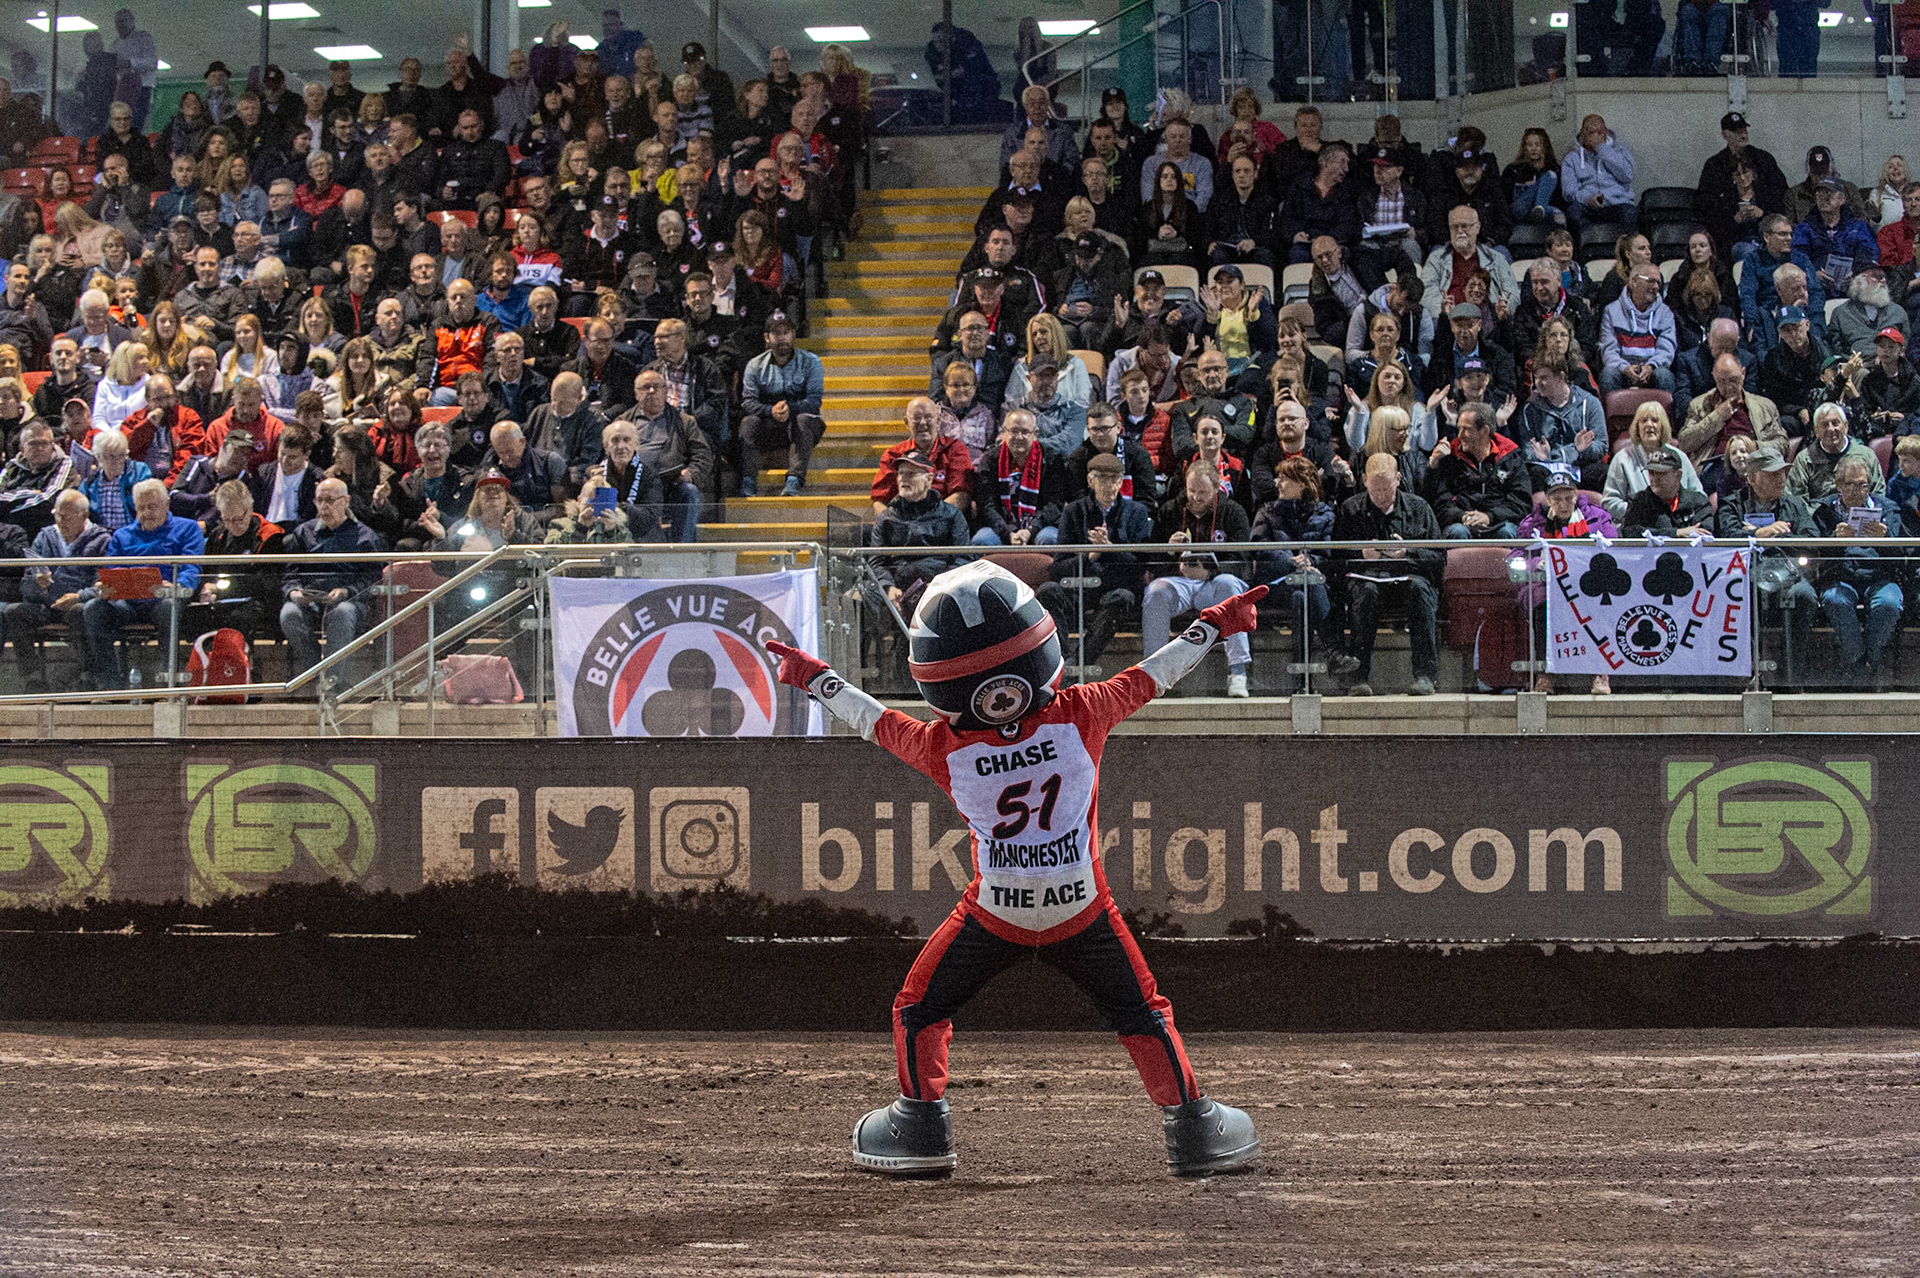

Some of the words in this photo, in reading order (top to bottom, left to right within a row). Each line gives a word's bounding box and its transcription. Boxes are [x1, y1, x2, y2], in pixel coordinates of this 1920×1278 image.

[1550, 547, 1624, 670] BELLE
[1680, 563, 1723, 649] VUE
[586, 606, 656, 687] BELLE
[666, 594, 729, 622] VUE
[737, 612, 784, 680] AC
[1555, 631, 1578, 643] EST
[1663, 617, 1678, 643] ACES
[1557, 647, 1587, 659] 1928
[1617, 635, 1672, 666] MANCHESTER
[975, 740, 1058, 777] CHASE
[985, 828, 1081, 868] MANCHESTER
[990, 885, 1035, 909] THE
[1042, 880, 1087, 907] ACE
